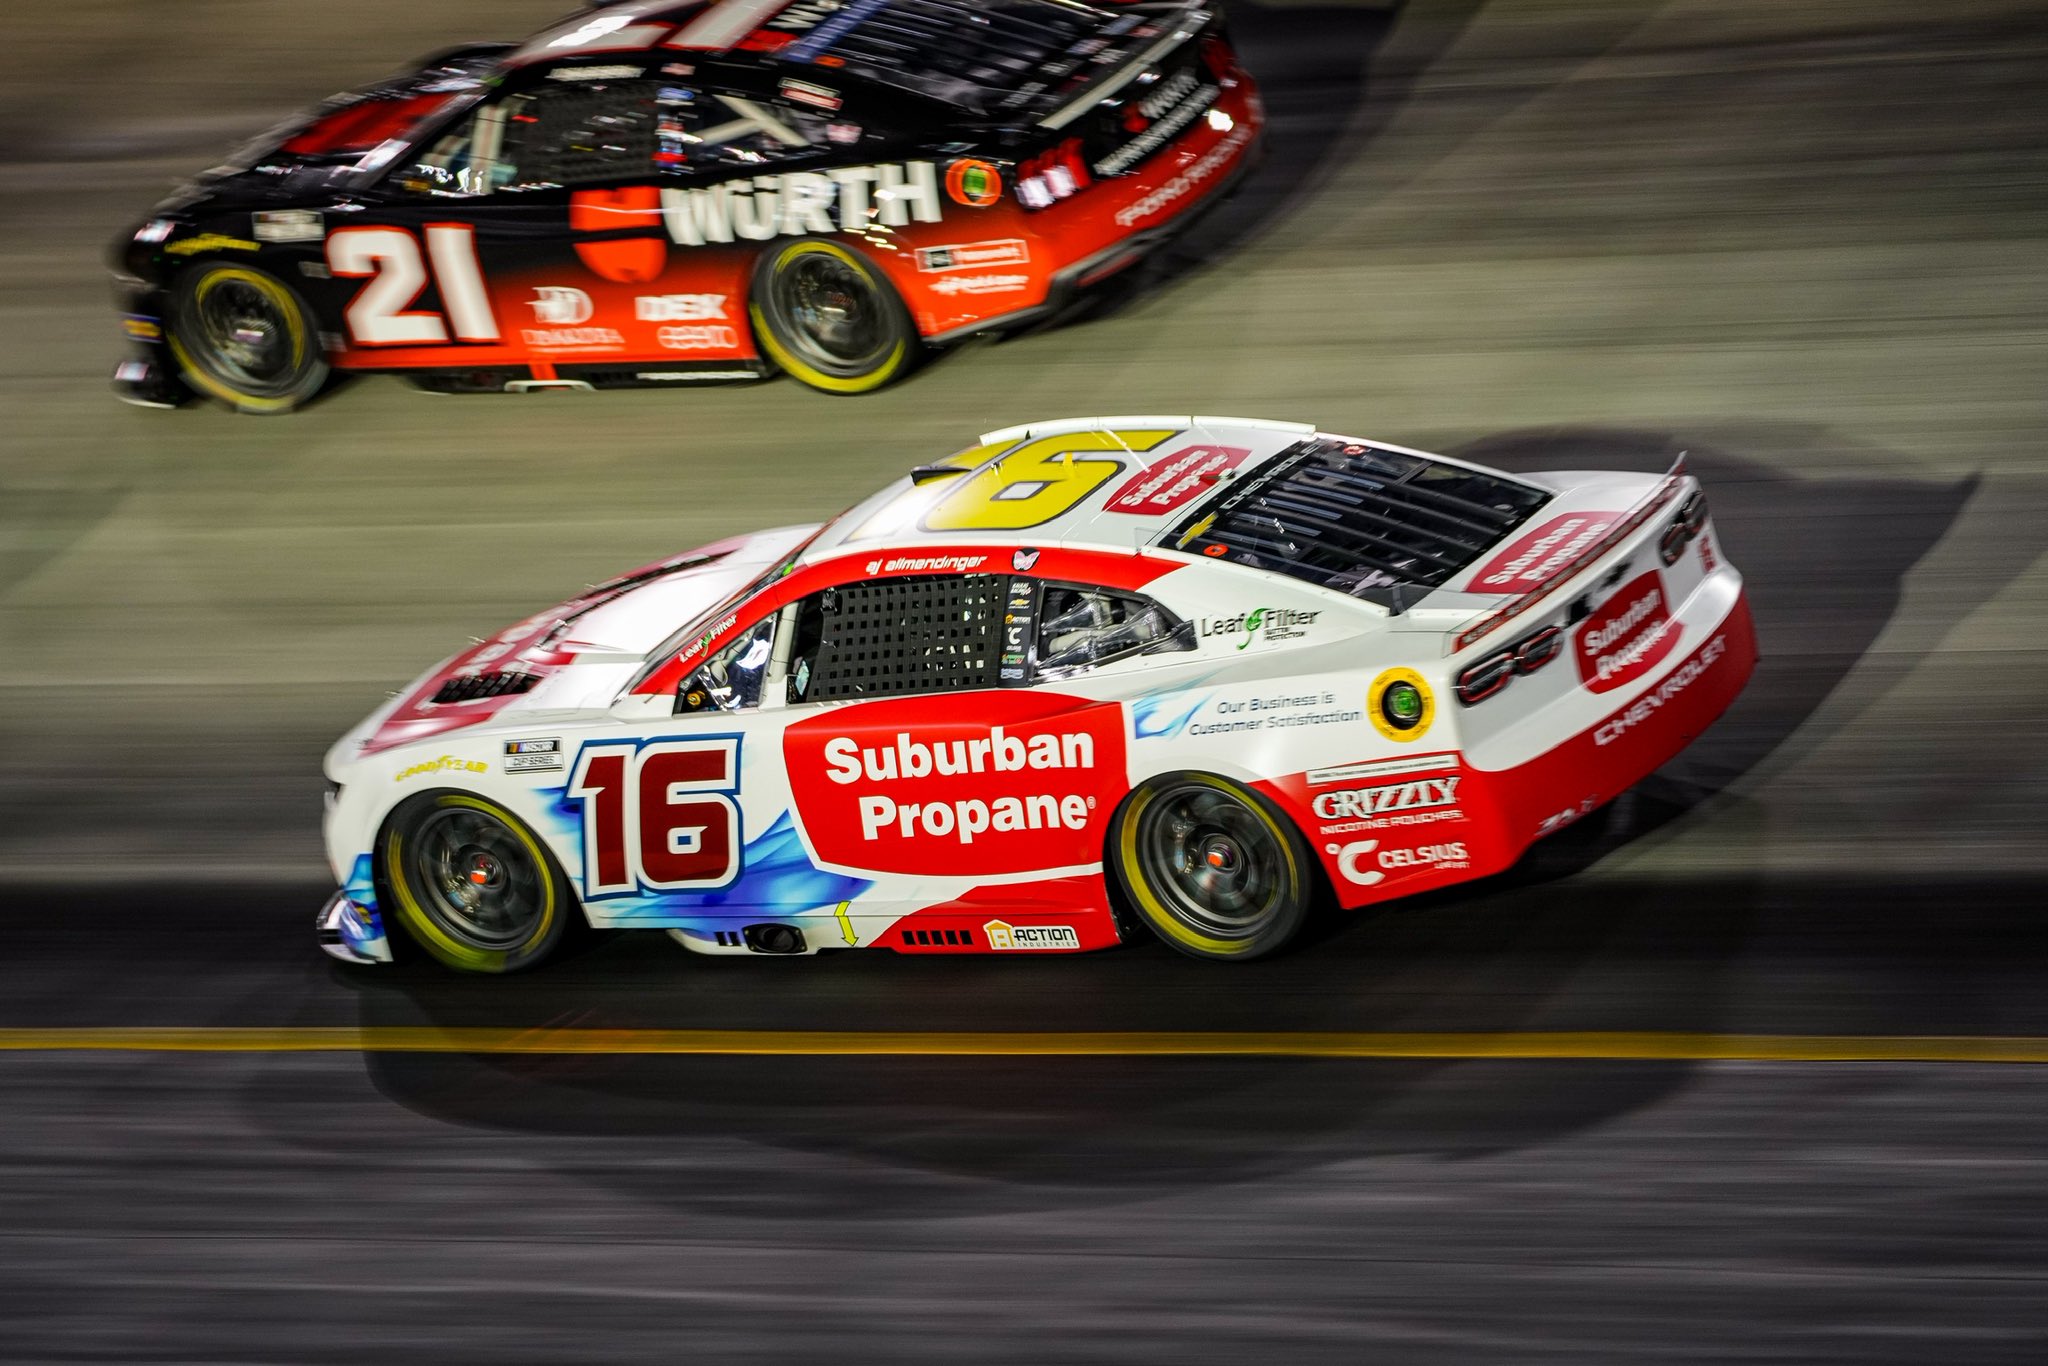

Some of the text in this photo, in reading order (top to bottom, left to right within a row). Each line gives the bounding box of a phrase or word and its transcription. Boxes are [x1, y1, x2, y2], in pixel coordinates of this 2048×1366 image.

[326, 222, 500, 348] 21
[1120, 449, 1209, 507] Suburban
[1150, 454, 1229, 506] Propane
[884, 555, 988, 572] allmendinger
[1483, 518, 1588, 585] Suburban
[1518, 522, 1608, 582] Propane
[1584, 588, 1662, 657] Suburban
[1217, 690, 1336, 715] Our Business is
[1593, 634, 1726, 746] CHEVROLET
[1189, 709, 1364, 736] Customer Satisfaction
[824, 726, 1095, 785] Suburban
[567, 736, 741, 898] 16
[1311, 775, 1463, 820] GRIZZLY
[1320, 810, 1465, 835] NICOTINE POUCHES
[1377, 842, 1470, 869] CELSIUS
[1014, 928, 1075, 941] ACTION
